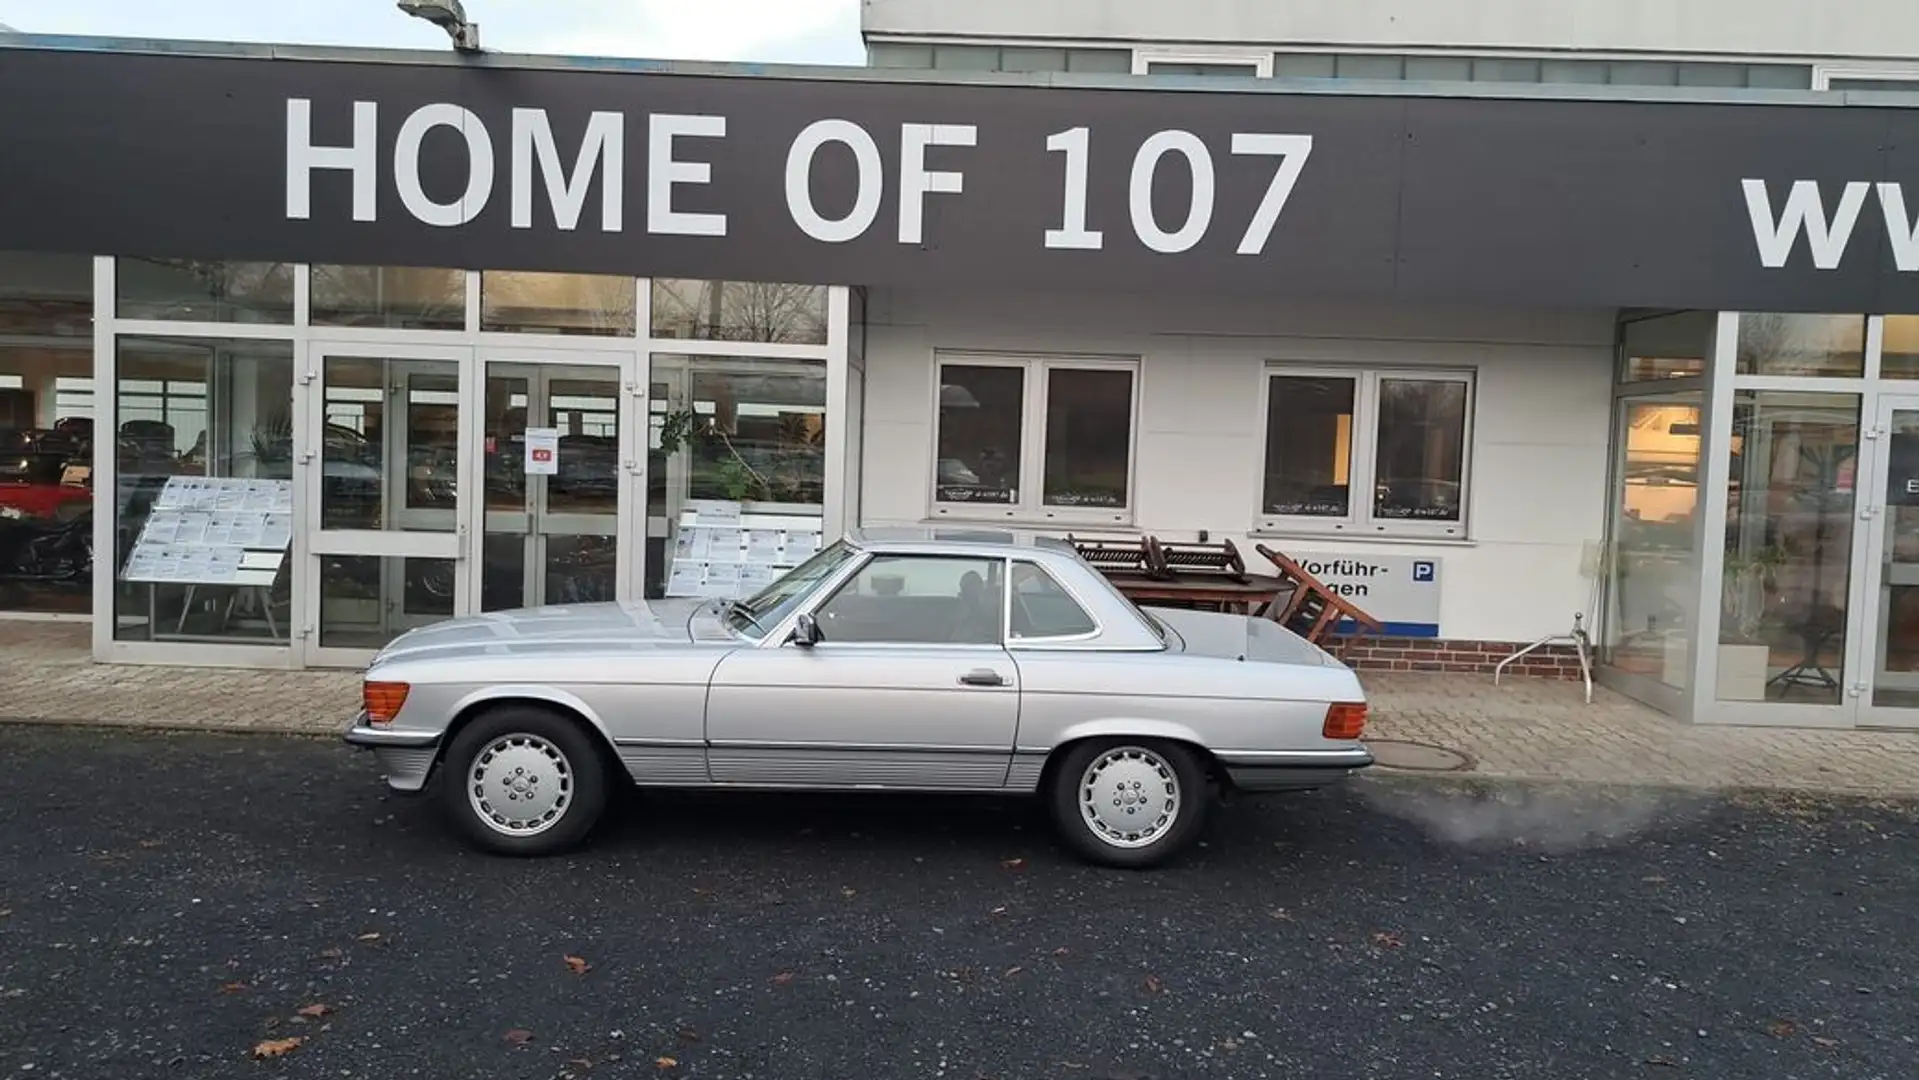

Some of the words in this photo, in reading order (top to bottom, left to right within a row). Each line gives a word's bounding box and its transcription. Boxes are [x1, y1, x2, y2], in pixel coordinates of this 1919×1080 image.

[287, 98, 726, 236] HOME
[786, 119, 977, 244] OF
[1045, 127, 1313, 255] 107
[1416, 564, 1431, 579] P
